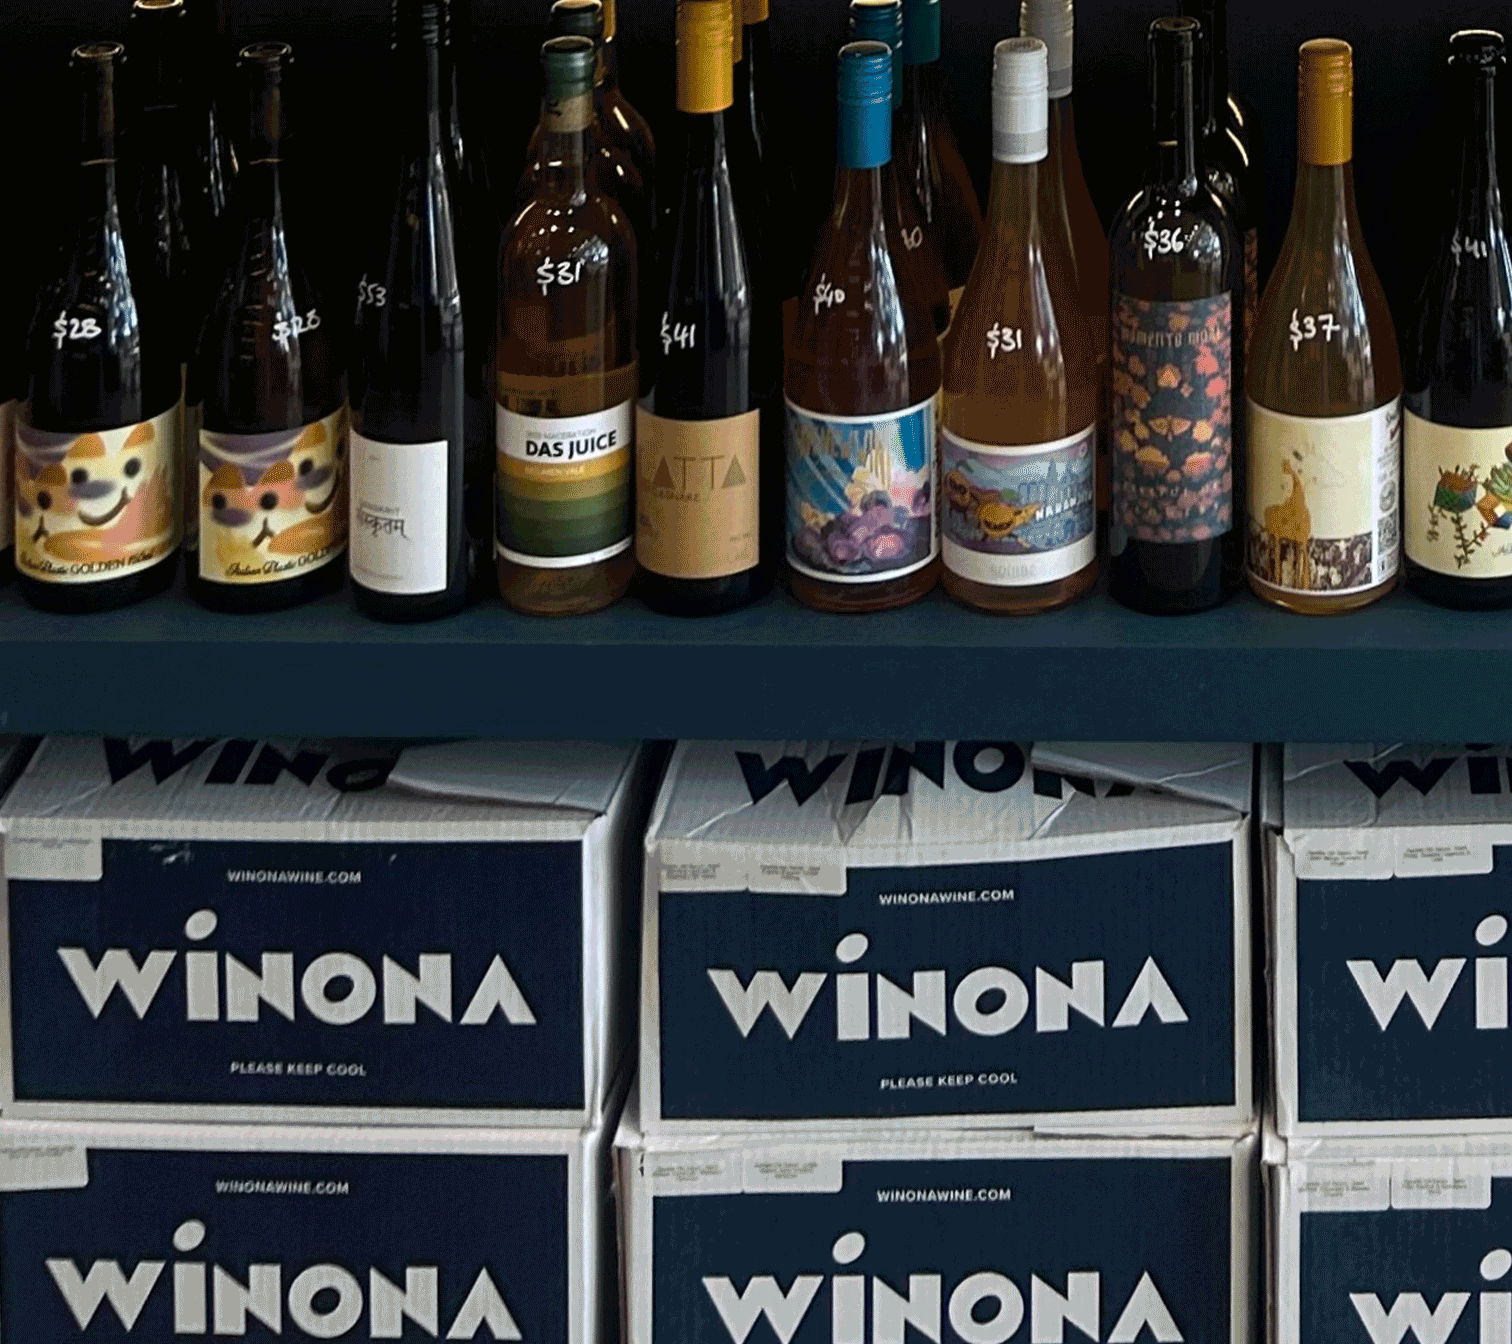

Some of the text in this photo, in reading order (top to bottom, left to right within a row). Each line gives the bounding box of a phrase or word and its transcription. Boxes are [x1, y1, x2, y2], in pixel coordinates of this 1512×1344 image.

[1143, 216, 1185, 260] $36
[53, 311, 101, 349] $28
[660, 311, 696, 355] $41
[1289, 309, 1341, 351] $37
[986, 322, 1022, 359] $31
[526, 430, 617, 459] DAS JUICE
[70, 557, 126, 575] GOLDEN
[227, 869, 361, 885] WINONAWINE.COM
[879, 887, 1015, 905] WINONAWINE.COM
[230, 1061, 367, 1076] PLEASE KEEP COOL
[880, 1071, 1019, 1090] PLEASE KEEP COOL
[215, 1179, 350, 1195] WINONAWINE.COM
[876, 1187, 1012, 1203] WINONAWINE.COM
